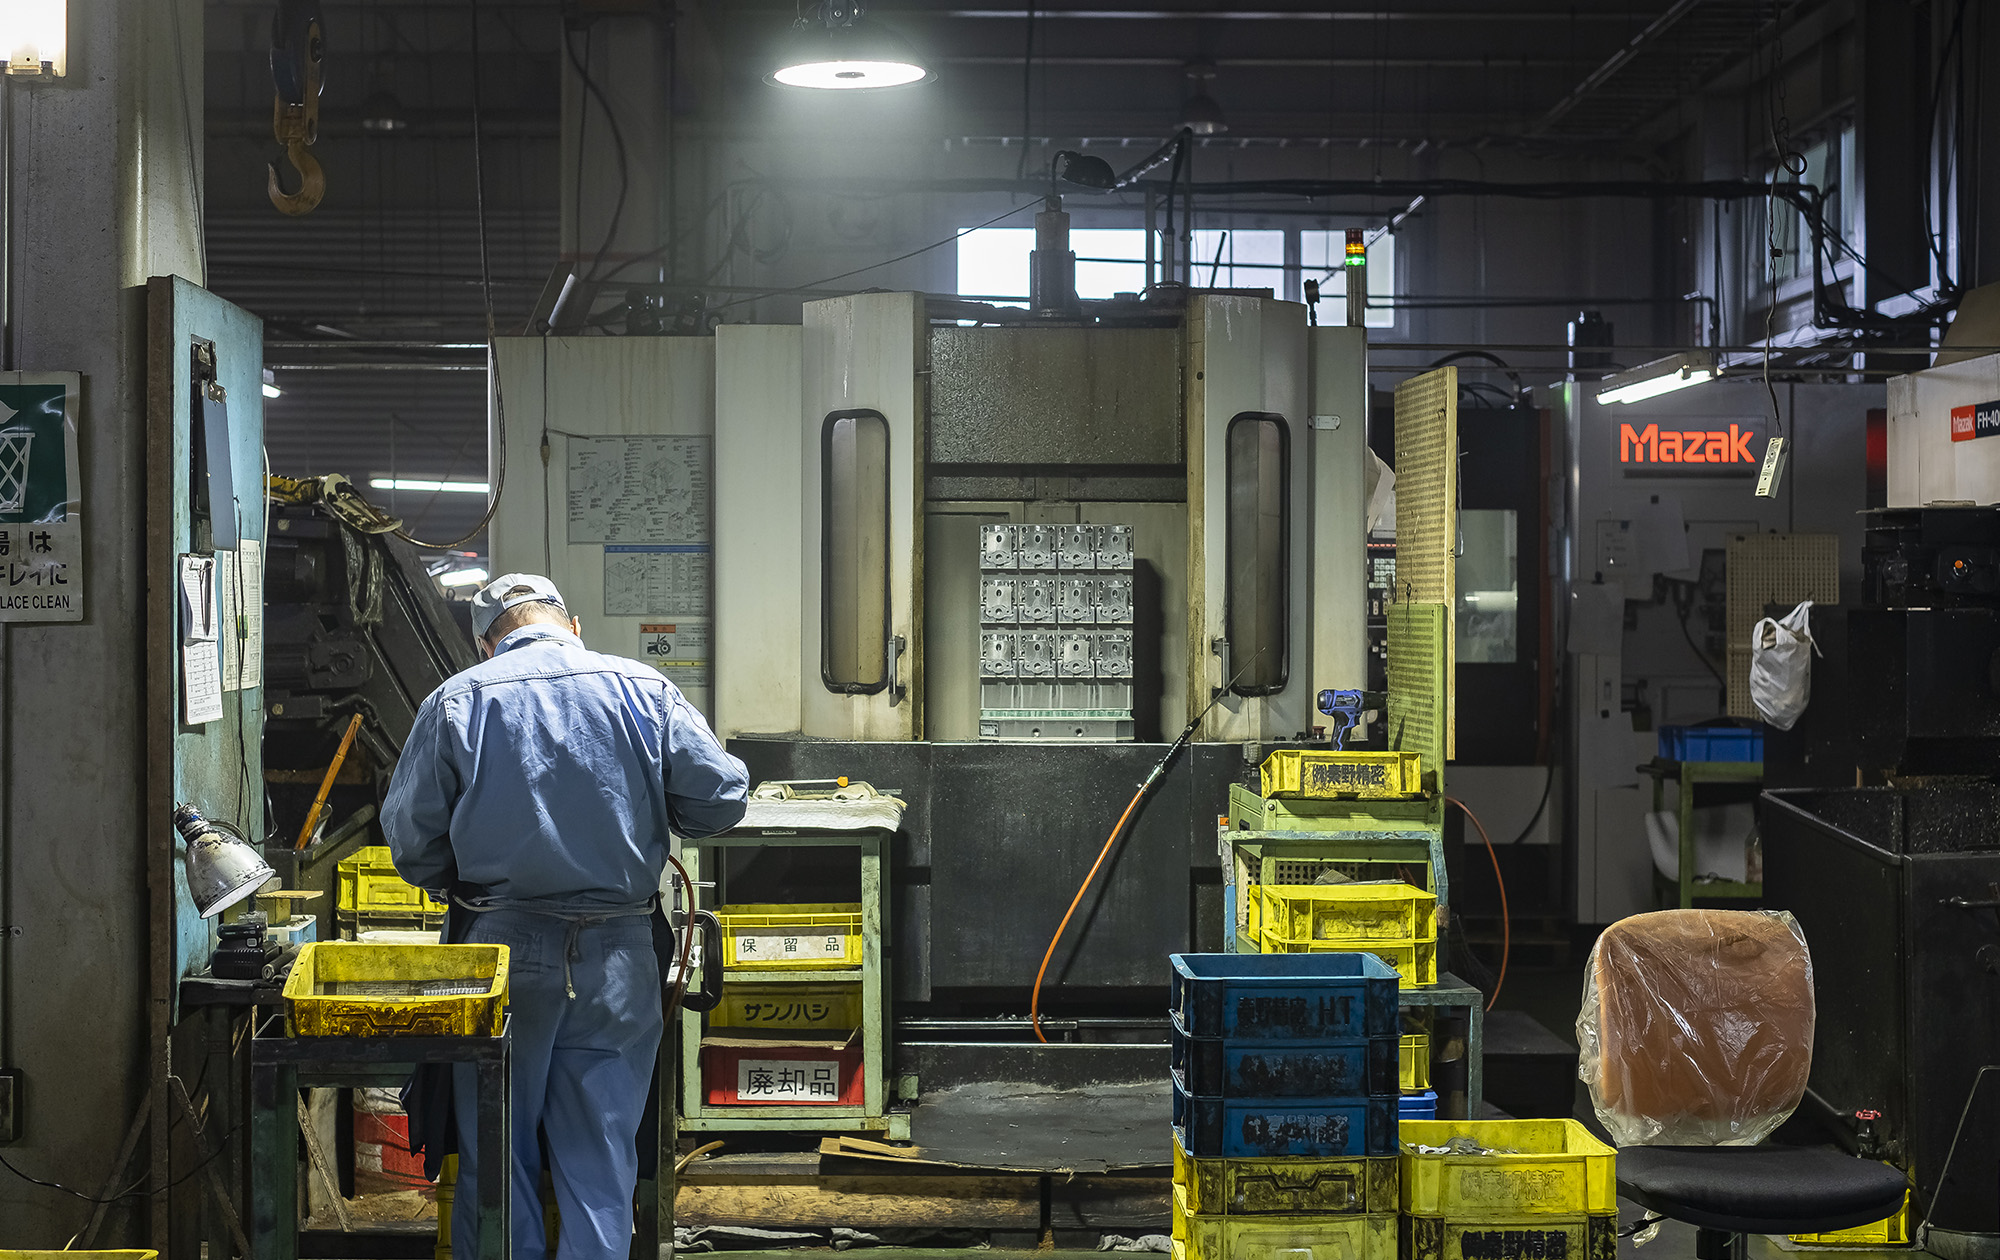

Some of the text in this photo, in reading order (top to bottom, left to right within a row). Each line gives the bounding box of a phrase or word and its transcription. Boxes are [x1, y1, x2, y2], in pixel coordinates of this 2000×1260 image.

[1953, 414, 1974, 434] Mazak
[1620, 423, 1756, 463] Mazak
[32, 594, 70, 609] CLEAN
[741, 937, 840, 953] 保留品
[744, 1003, 830, 1021] サンノハシ
[746, 1067, 836, 1096] 廃却品
